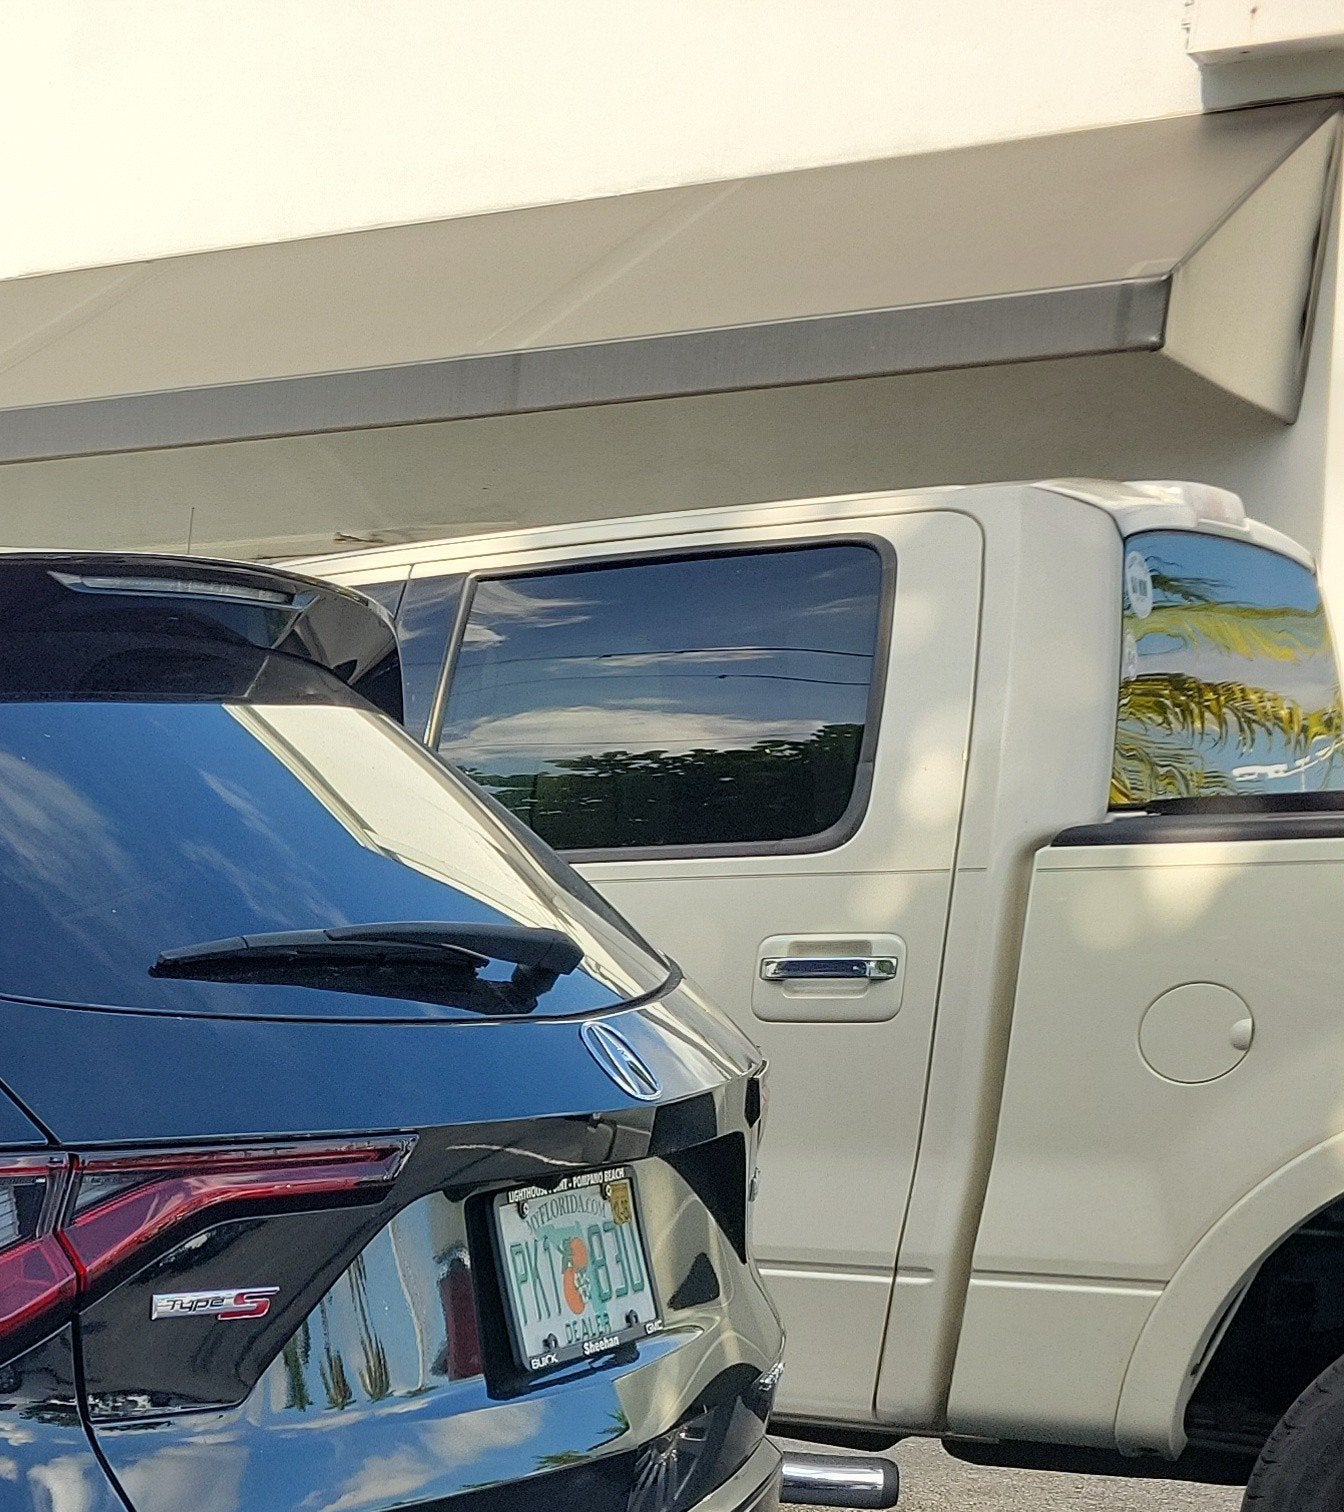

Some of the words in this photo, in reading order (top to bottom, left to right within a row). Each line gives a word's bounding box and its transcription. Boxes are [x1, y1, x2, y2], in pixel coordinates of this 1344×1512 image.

[572, 1171, 603, 1188] POMPANO
[604, 1167, 625, 1182] BEACH
[217, 1286, 280, 1320] S
[564, 1312, 611, 1343] DEALER
[531, 1353, 559, 1370] BUICK
[583, 1336, 619, 1355] Sheehan
